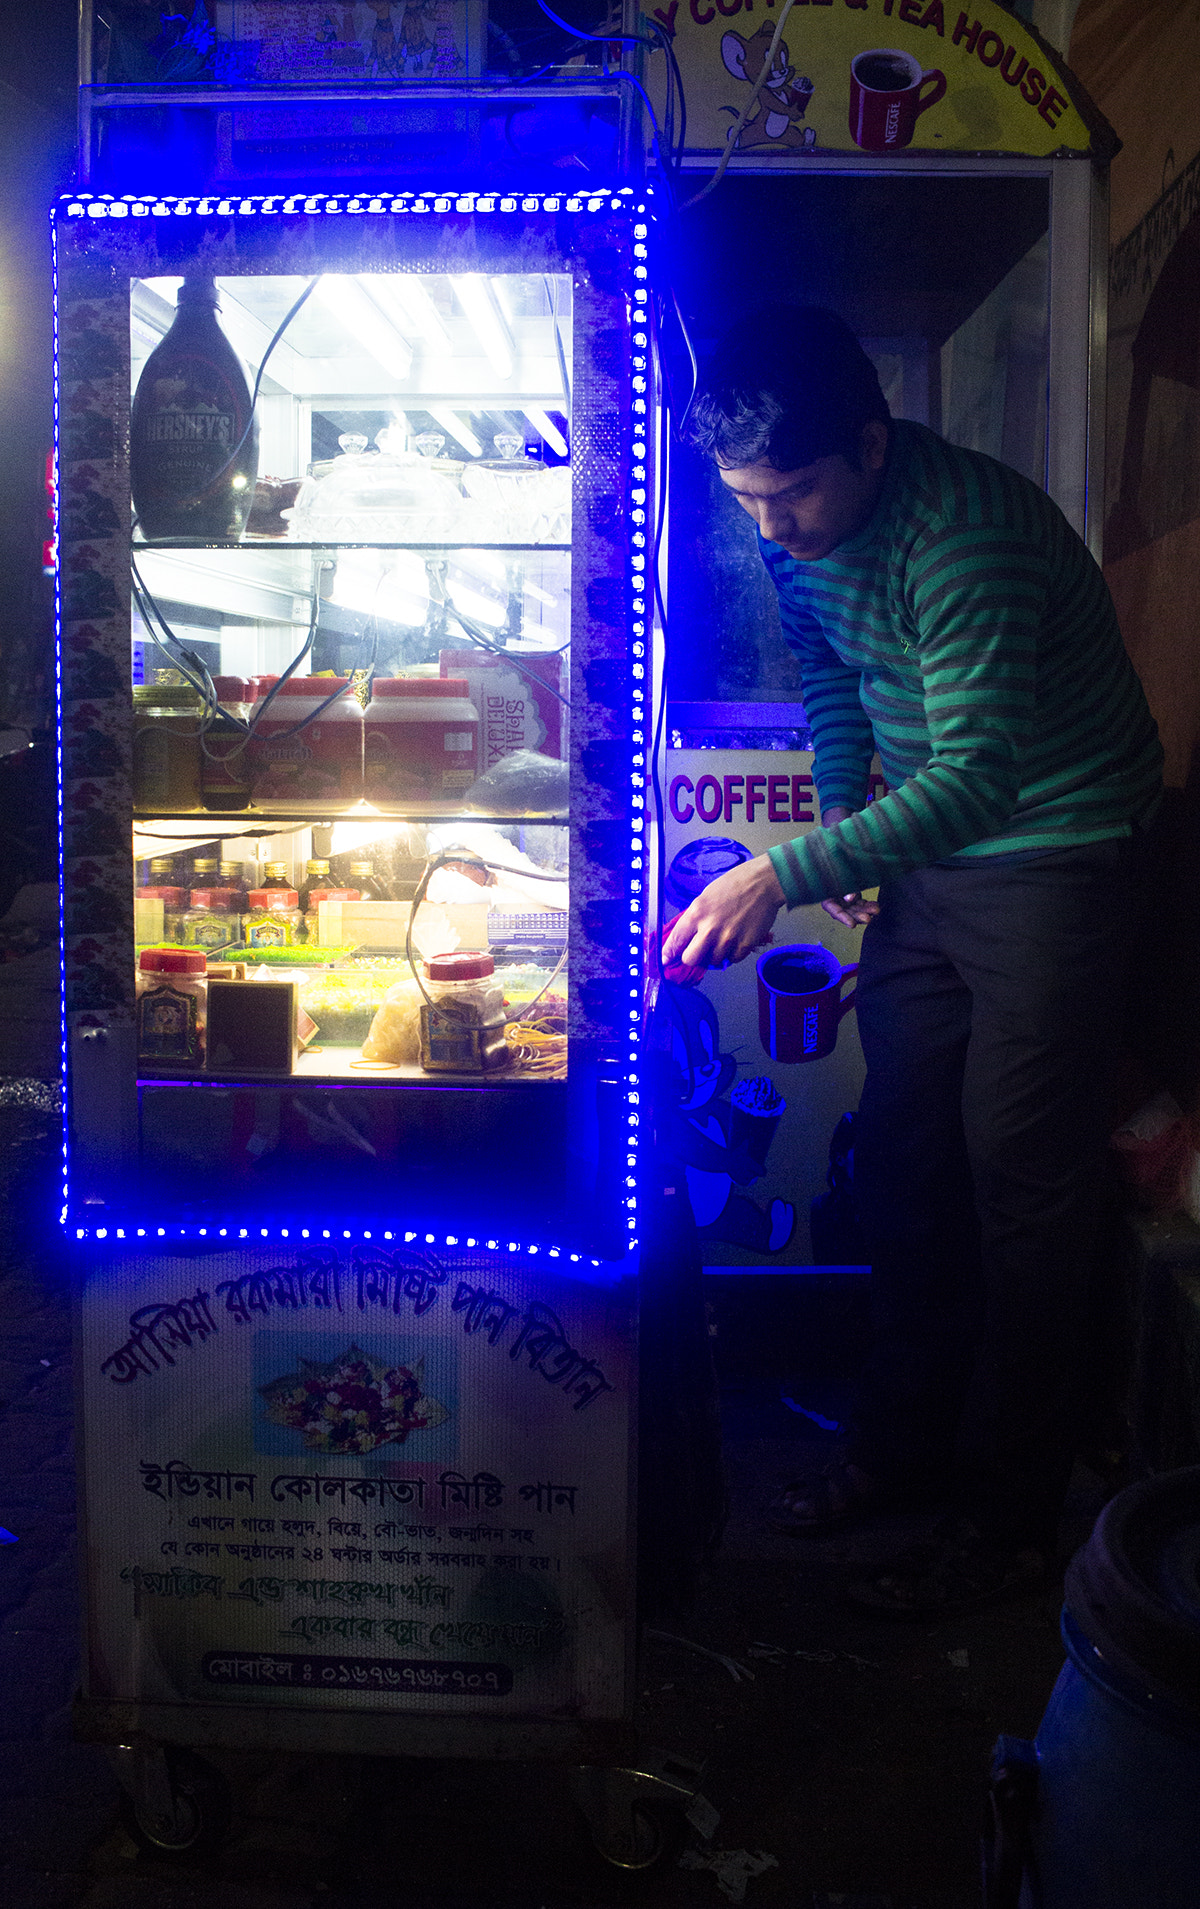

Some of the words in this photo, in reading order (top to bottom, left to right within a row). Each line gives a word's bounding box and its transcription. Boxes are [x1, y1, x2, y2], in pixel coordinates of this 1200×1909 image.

[952, 11, 1069, 130] HOUSE
[146, 413, 231, 444] HERSHEY'S
[669, 774, 815, 824] COFFEE
[451, 1281, 520, 1345] পান
[509, 1301, 615, 1411] বিতান
[139, 1459, 257, 1503] ইন্ডিয়ান
[270, 1472, 427, 1510] কোলকাতা
[435, 1470, 505, 1512] মিষ্টি
[518, 1480, 578, 1515] পান
[187, 1515, 235, 1532] এখানে
[240, 1516, 275, 1533] গায়ে
[280, 1518, 321, 1538] হলুদ,
[327, 1516, 367, 1540] বিয়ে,
[509, 1528, 535, 1544] সহ
[160, 1540, 178, 1556] যে
[184, 1540, 221, 1558] কোন
[225, 1539, 296, 1562] অনুষ্ঠানের
[301, 1546, 324, 1563] ২৪
[329, 1544, 373, 1564] ঘন্টার
[377, 1545, 423, 1566] অর্ডার
[426, 1550, 488, 1569] সরবরাহ
[491, 1553, 524, 1571] করা
[278, 1614, 378, 1642] একবার
[208, 1656, 294, 1681] মোবাইল
[321, 1664, 499, 1689] ০১৬৭৬৭৬৮৭০৭
